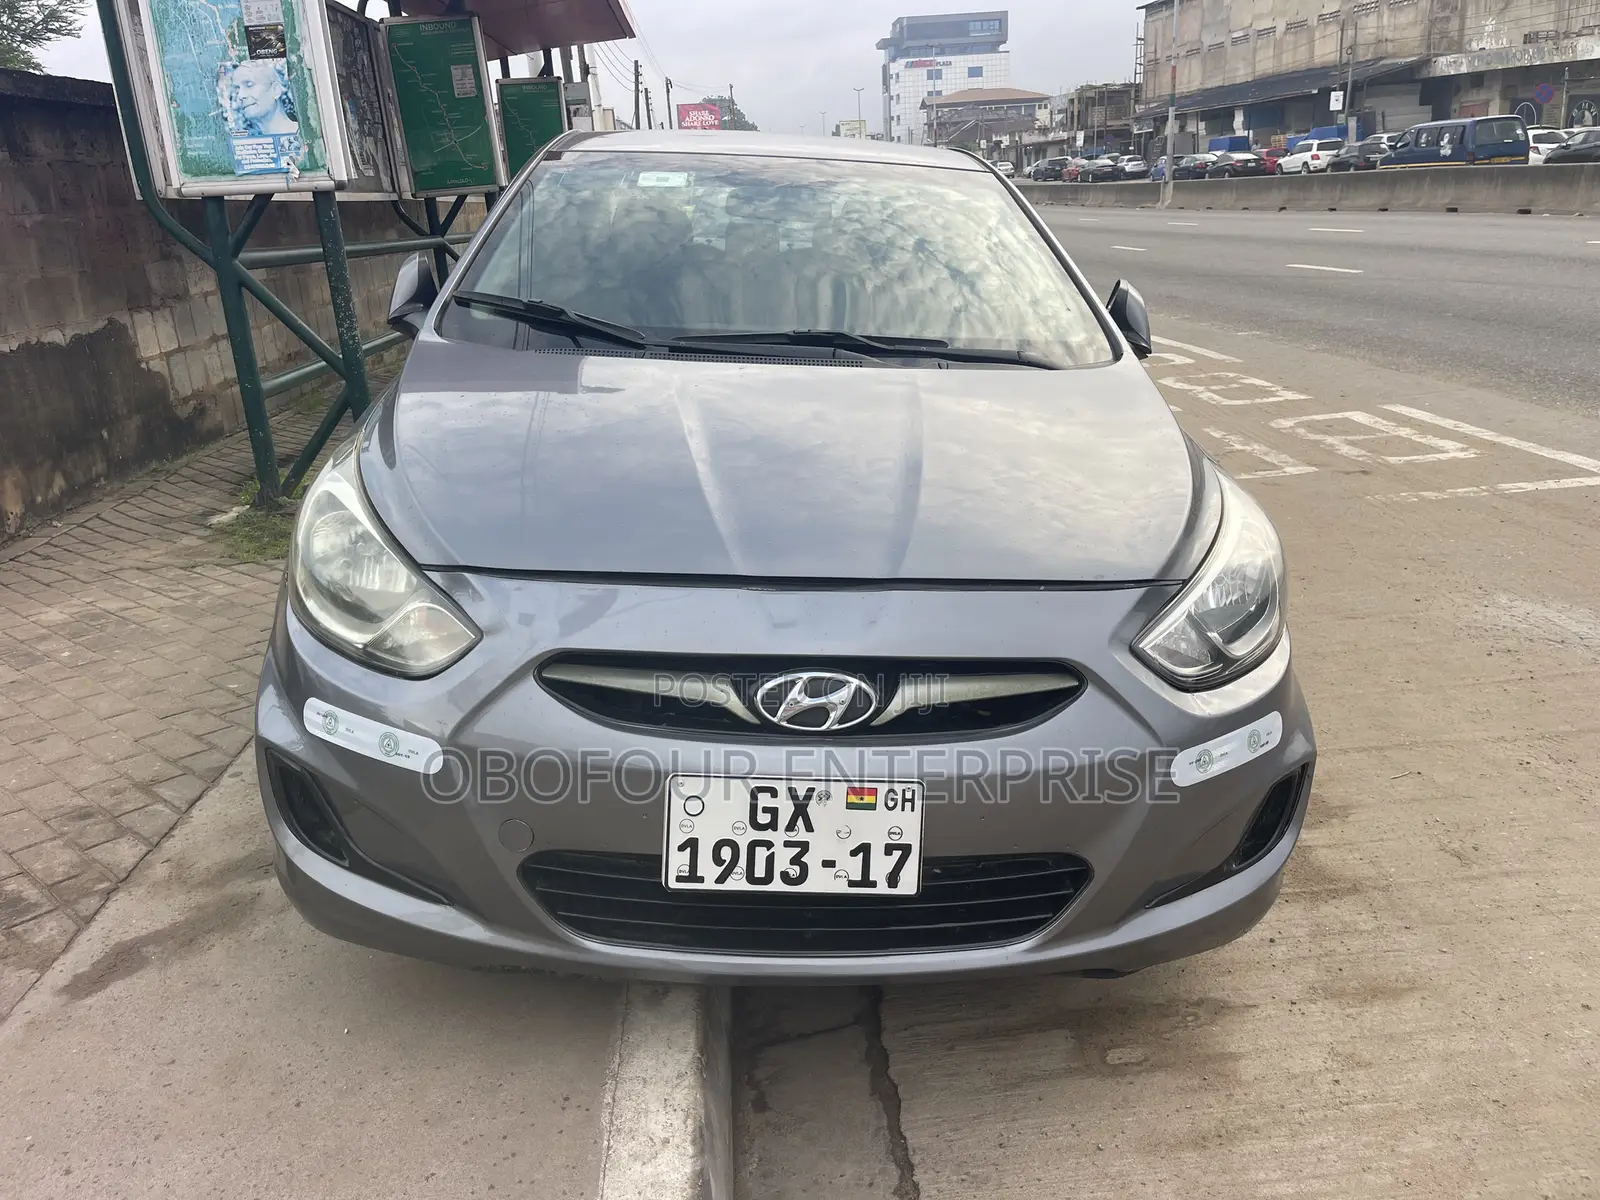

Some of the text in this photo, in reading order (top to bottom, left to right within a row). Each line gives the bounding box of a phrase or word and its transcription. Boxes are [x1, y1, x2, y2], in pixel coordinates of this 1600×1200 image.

[419, 21, 457, 32] INBOUND
[748, 785, 916, 833] GX GH
[675, 837, 913, 888] 1903-17
